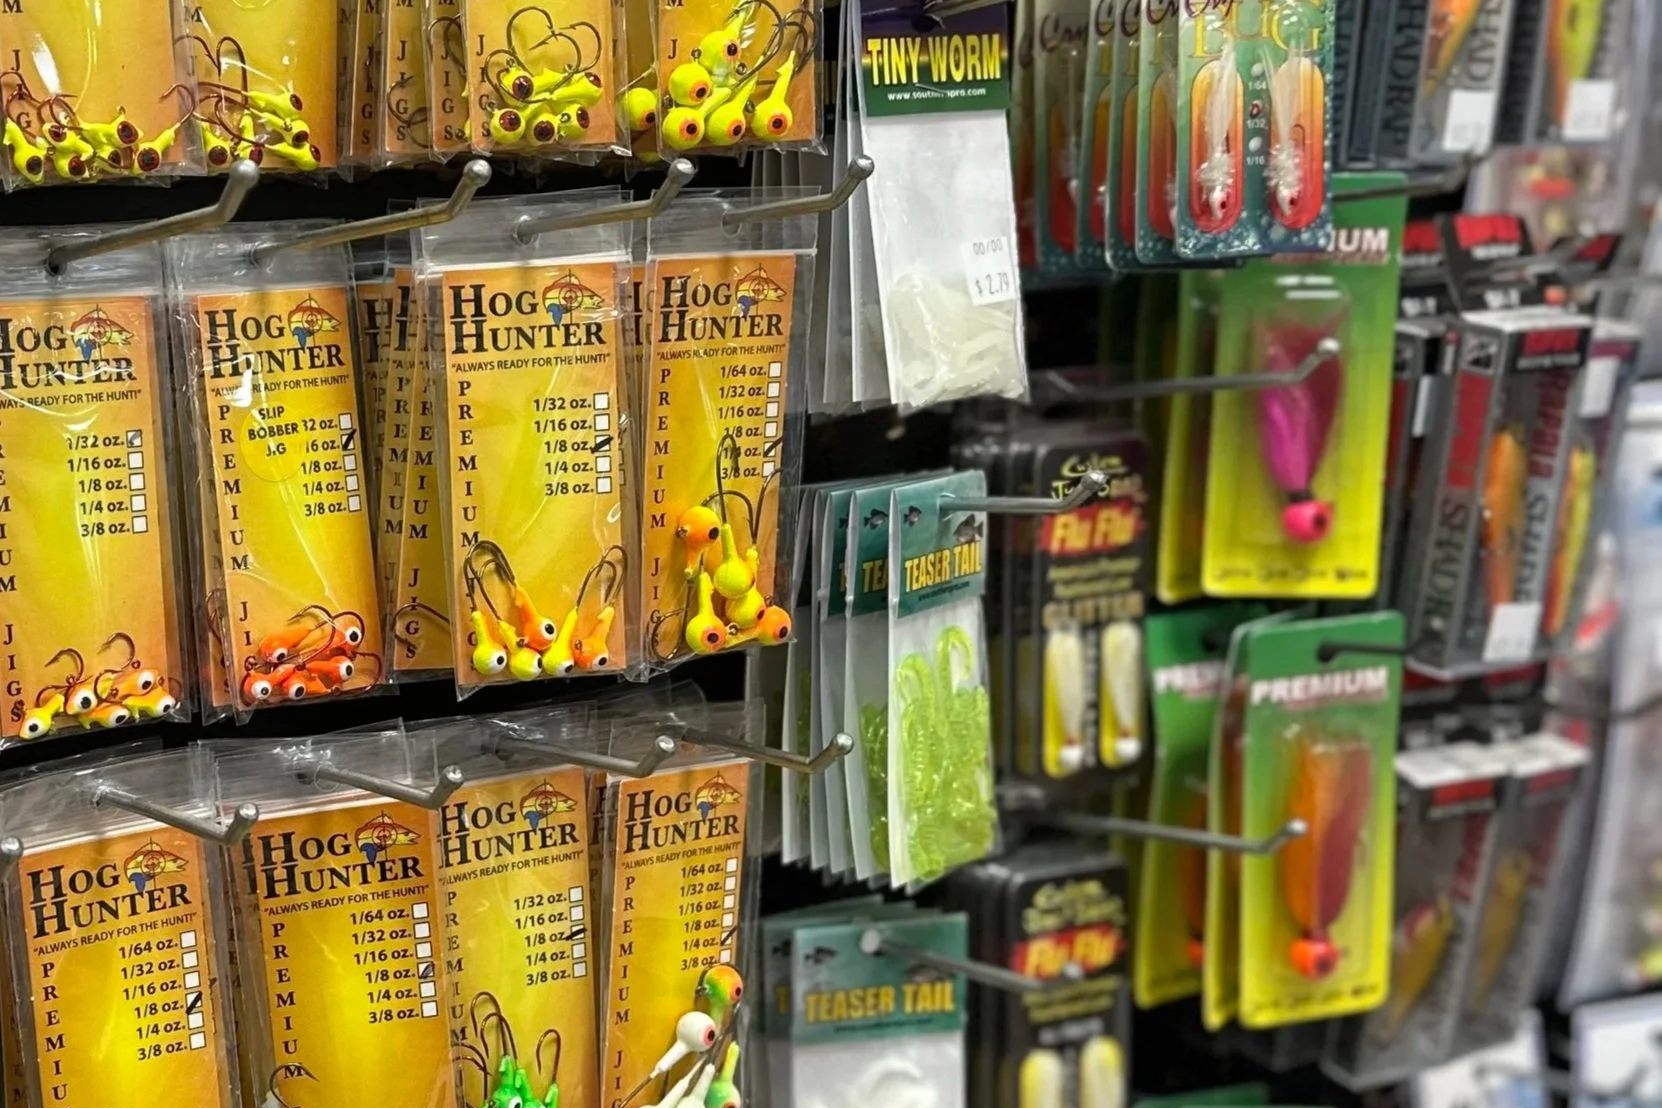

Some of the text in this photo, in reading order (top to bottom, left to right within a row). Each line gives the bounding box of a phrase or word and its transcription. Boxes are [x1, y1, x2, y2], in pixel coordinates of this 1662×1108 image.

[867, 33, 1001, 86] TINY WORM
[1246, 155, 1265, 166] 1/16
[449, 283, 537, 319] HOG
[661, 275, 733, 309] HOG
[204, 309, 286, 345] HOG
[658, 308, 784, 343] HUNTER
[452, 320, 607, 355] HUNTER
[208, 344, 346, 379] HUNTER
[497, 357, 530, 371] READY
[531, 356, 553, 367] FOR
[553, 354, 573, 366] THE
[720, 364, 767, 378] 1/64 oz.
[719, 385, 765, 399] 1/32 oz.
[258, 406, 285, 420] SLIP
[533, 397, 592, 412] 1/32 oz.
[718, 405, 764, 419] 1/16 oz.
[248, 422, 299, 441] BOBBER
[533, 418, 593, 433] 1/16 oz.
[544, 440, 568, 454] 1/8
[302, 480, 345, 496] 1/4 oz.
[904, 549, 950, 593] TEASER
[953, 540, 982, 577] TAIL
[1251, 666, 1389, 705] PREMIUM
[625, 788, 693, 823] HOG
[439, 800, 516, 837] HOG
[623, 814, 740, 855] HUNTER
[257, 831, 352, 867] HOG
[437, 822, 580, 870] HUNTER
[27, 863, 121, 906] HOG
[261, 855, 425, 900] HUNTER
[31, 883, 193, 939] HUNTER
[311, 896, 345, 911] READY
[347, 892, 369, 905] FOR
[370, 889, 391, 902] THE
[350, 907, 410, 926] 1/64 oz.
[80, 930, 115, 948] READY
[117, 926, 138, 941] FOR
[139, 920, 160, 936] THE
[351, 927, 412, 946] 1/32 oz.
[118, 938, 179, 960] 1/64 oz.
[353, 947, 414, 966] 1/16 oz.
[120, 958, 181, 980] 1/32 oz.
[365, 966, 416, 984] 1/8 oz.
[122, 978, 182, 1000] 1/16 oz.
[367, 986, 418, 1004] 1/4 oz.
[134, 999, 184, 1020] 1/8 oz.
[805, 986, 895, 1024] TEASER
[902, 982, 955, 1013] TAIL
[368, 1006, 419, 1024] 3/8 oz.
[135, 1019, 186, 1040] 1/4 oz.
[137, 1039, 188, 1061] 3/8 oz.
